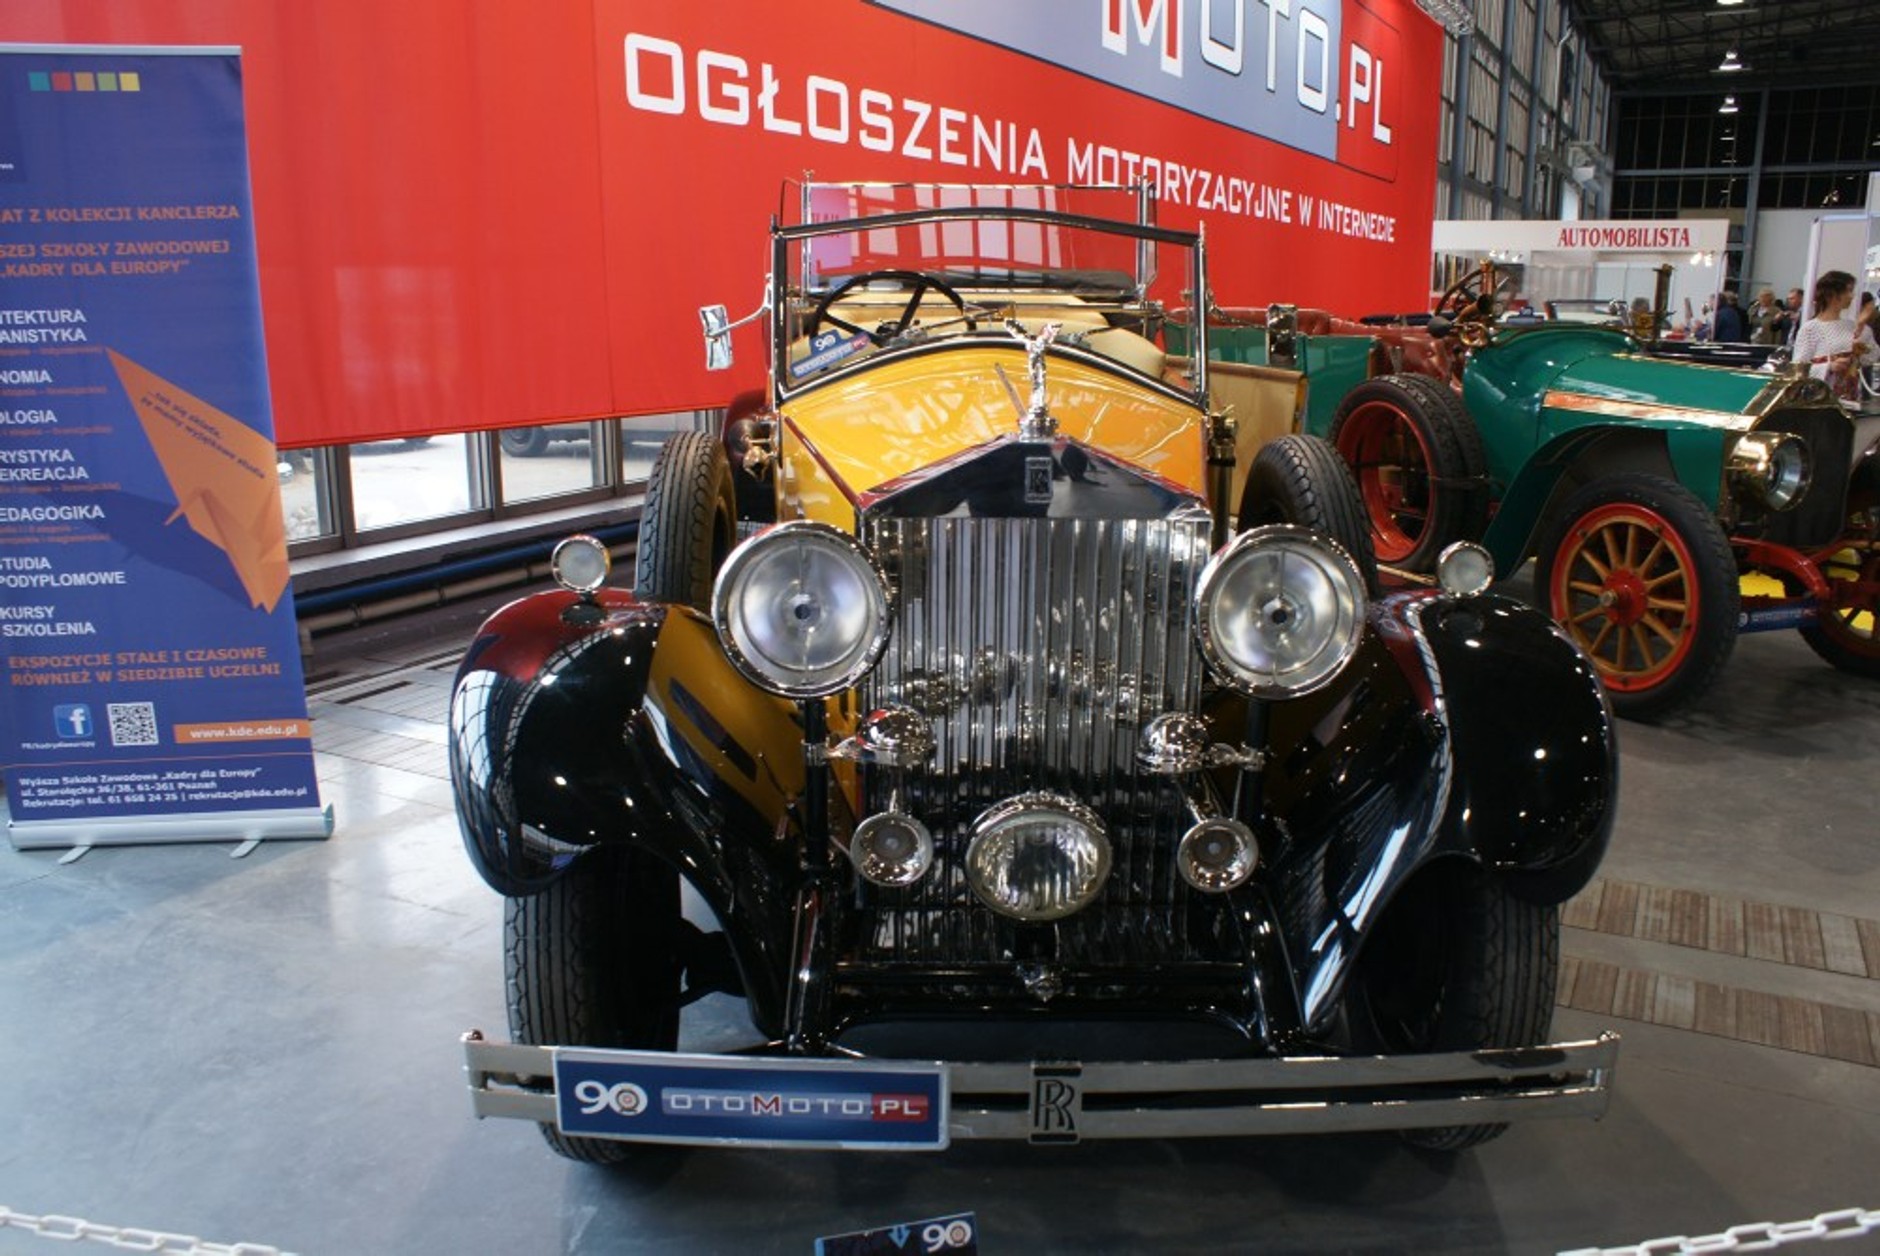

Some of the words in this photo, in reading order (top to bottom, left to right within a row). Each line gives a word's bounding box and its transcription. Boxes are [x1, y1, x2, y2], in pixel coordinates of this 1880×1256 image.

[624, 32, 1049, 180] OGŁOSZENIA
[1067, 136, 1292, 224] MOTORYZACYJNE
[1298, 193, 1313, 227] W
[1318, 199, 1396, 243] INTERNECIE
[0, 208, 22, 222] AT
[30, 208, 40, 221] Z
[46, 207, 131, 221] KOLEKCJI
[138, 205, 240, 219] KANCLERZA
[1558, 226, 1690, 248] AUTOMOBILISTA
[43, 242, 108, 256] SZKOŁY
[116, 240, 229, 254] ZAWODOWEJ
[72, 262, 106, 275] DLA
[0, 466, 89, 481] EKREACJA
[0, 505, 105, 521] EDAGOGIKA
[0, 605, 54, 620] KURSY
[2, 621, 96, 637] SZKOLENIA
[9, 654, 111, 669] EKSPOZYCJE
[117, 650, 167, 665] STAŁE
[173, 651, 179, 663] I
[186, 647, 267, 662] CZASOWE
[11, 670, 91, 686] RÓWNIEŻ
[96, 670, 112, 682] W
[118, 666, 205, 682] SIEDZIBIE
[209, 663, 281, 679] UCZELNI
[190, 723, 298, 739] www.kde.edu.pl
[100, 773, 158, 783] Zawodowa
[574, 1080, 648, 1116] 90
[922, 1220, 972, 1252] 90
